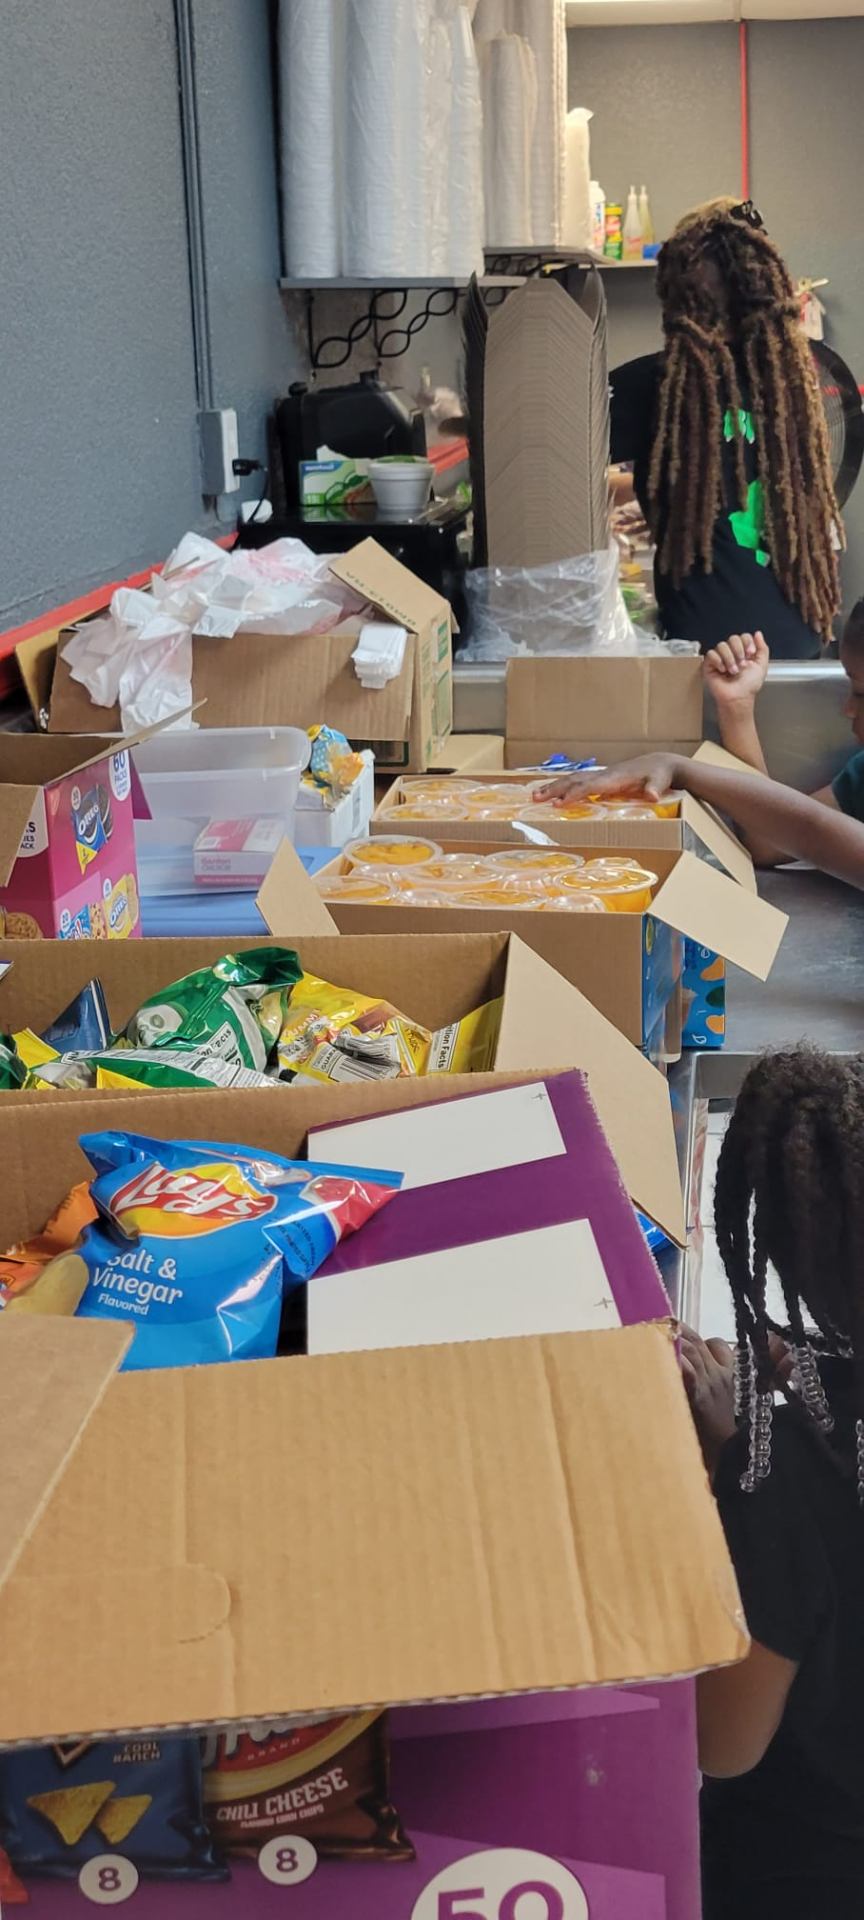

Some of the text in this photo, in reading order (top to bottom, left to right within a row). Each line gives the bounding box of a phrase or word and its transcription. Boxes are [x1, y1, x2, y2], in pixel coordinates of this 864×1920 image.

[158, 1258, 177, 1280] &
[93, 1267, 183, 1304] Vinegar
[98, 1293, 150, 1315] Flavored
[112, 1750, 161, 1764] RANCH
[216, 1767, 349, 1822] CHILI CHEESE
[276, 1847, 299, 1873] 8
[98, 1866, 122, 1892] 8
